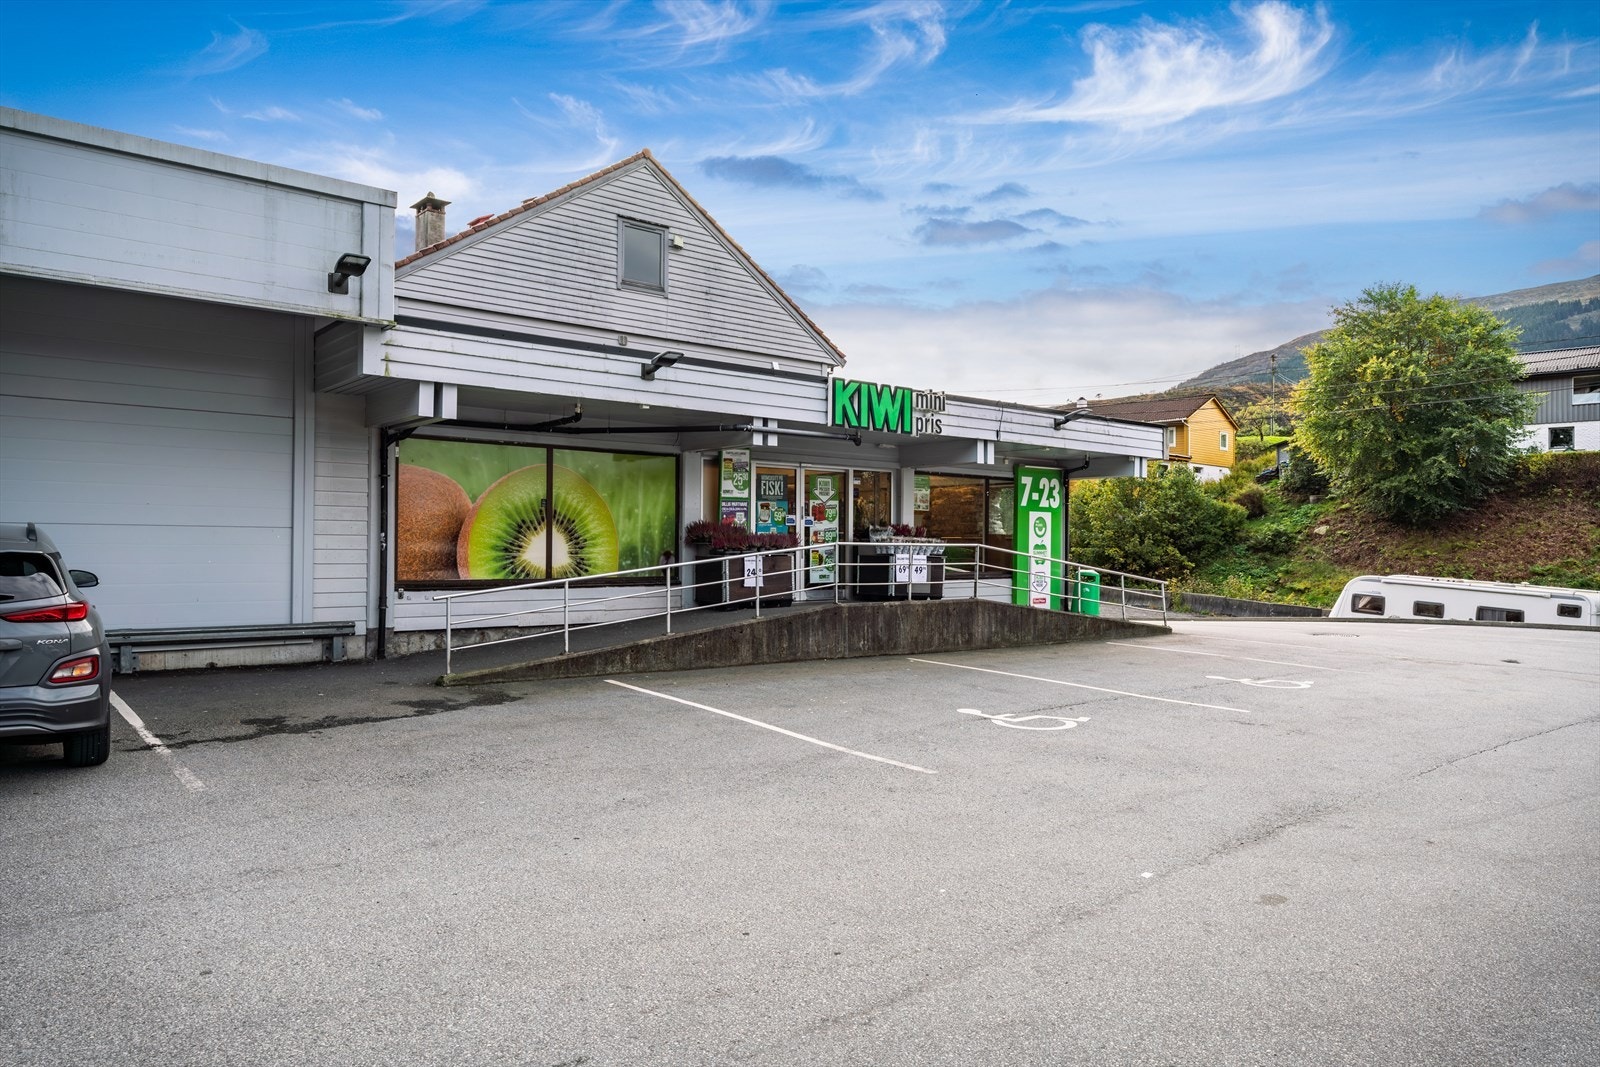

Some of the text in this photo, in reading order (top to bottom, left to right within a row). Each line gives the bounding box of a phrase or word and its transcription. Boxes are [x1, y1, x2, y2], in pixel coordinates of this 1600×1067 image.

[832, 377, 946, 435] KIWI mini
[915, 413, 943, 436] pris
[761, 480, 784, 496] FISK!
[1020, 476, 1060, 509] 7-23
